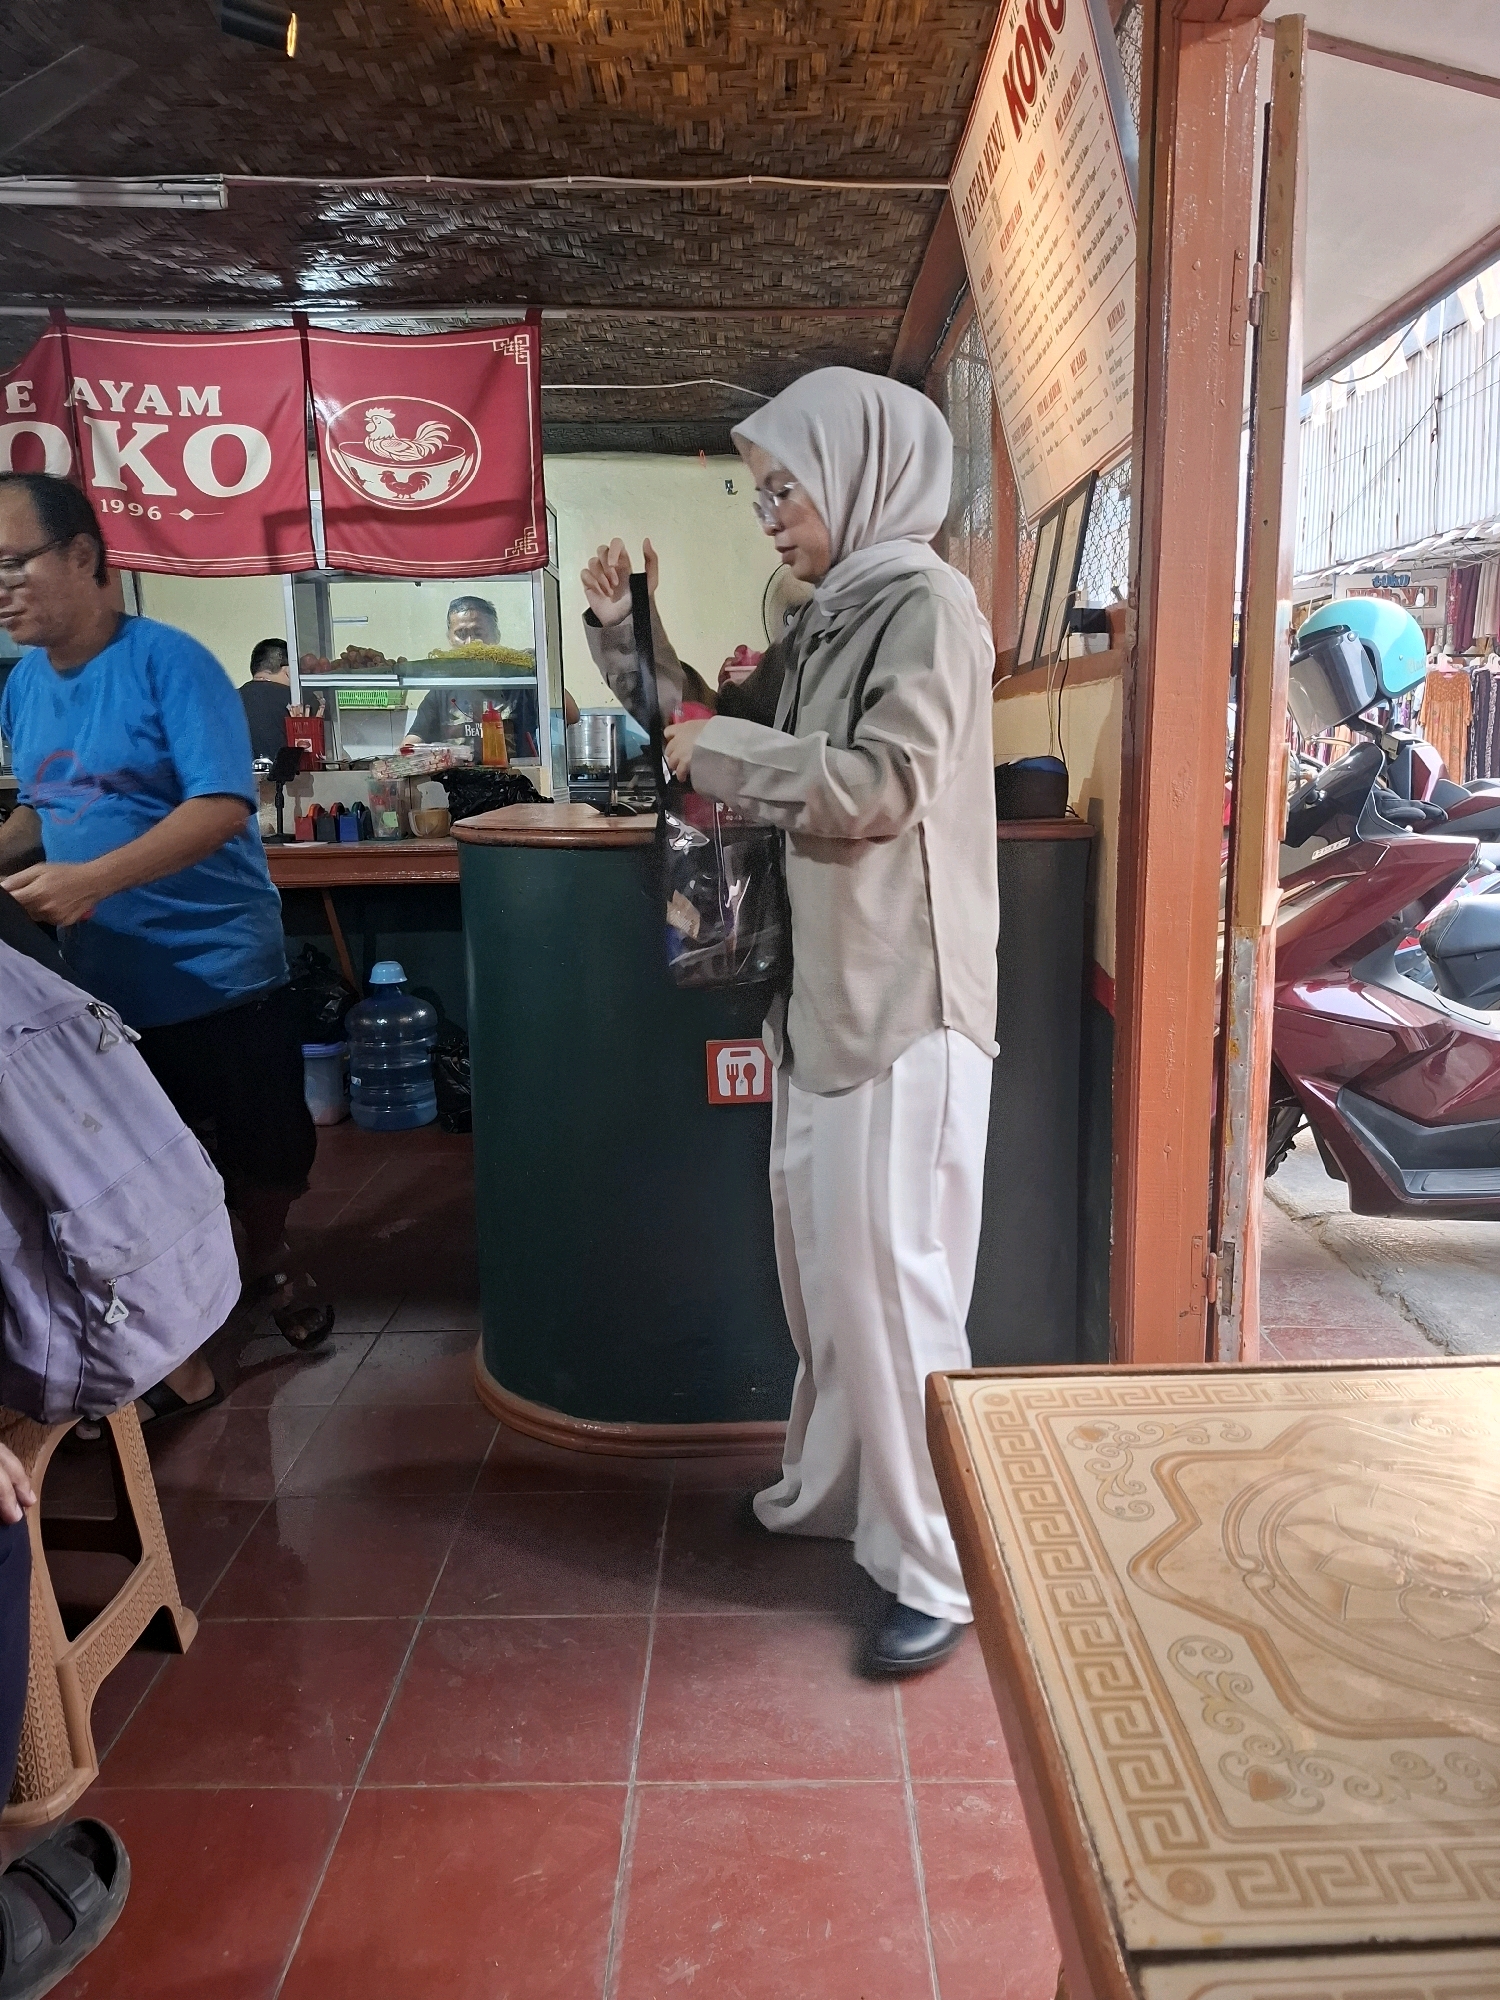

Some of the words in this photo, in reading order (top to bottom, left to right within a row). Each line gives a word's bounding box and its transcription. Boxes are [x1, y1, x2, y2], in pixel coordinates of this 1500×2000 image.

[1032, 94, 1047, 133] SEJAK
[1047, 64, 1058, 98] 1996
[962, 160, 988, 238] DAFTAR
[983, 111, 1005, 185] MENU
[63, 376, 223, 417] AYAM
[0, 415, 272, 498] OKO
[100, 498, 162, 521] 1996
[1372, 574, 1410, 588] toko
